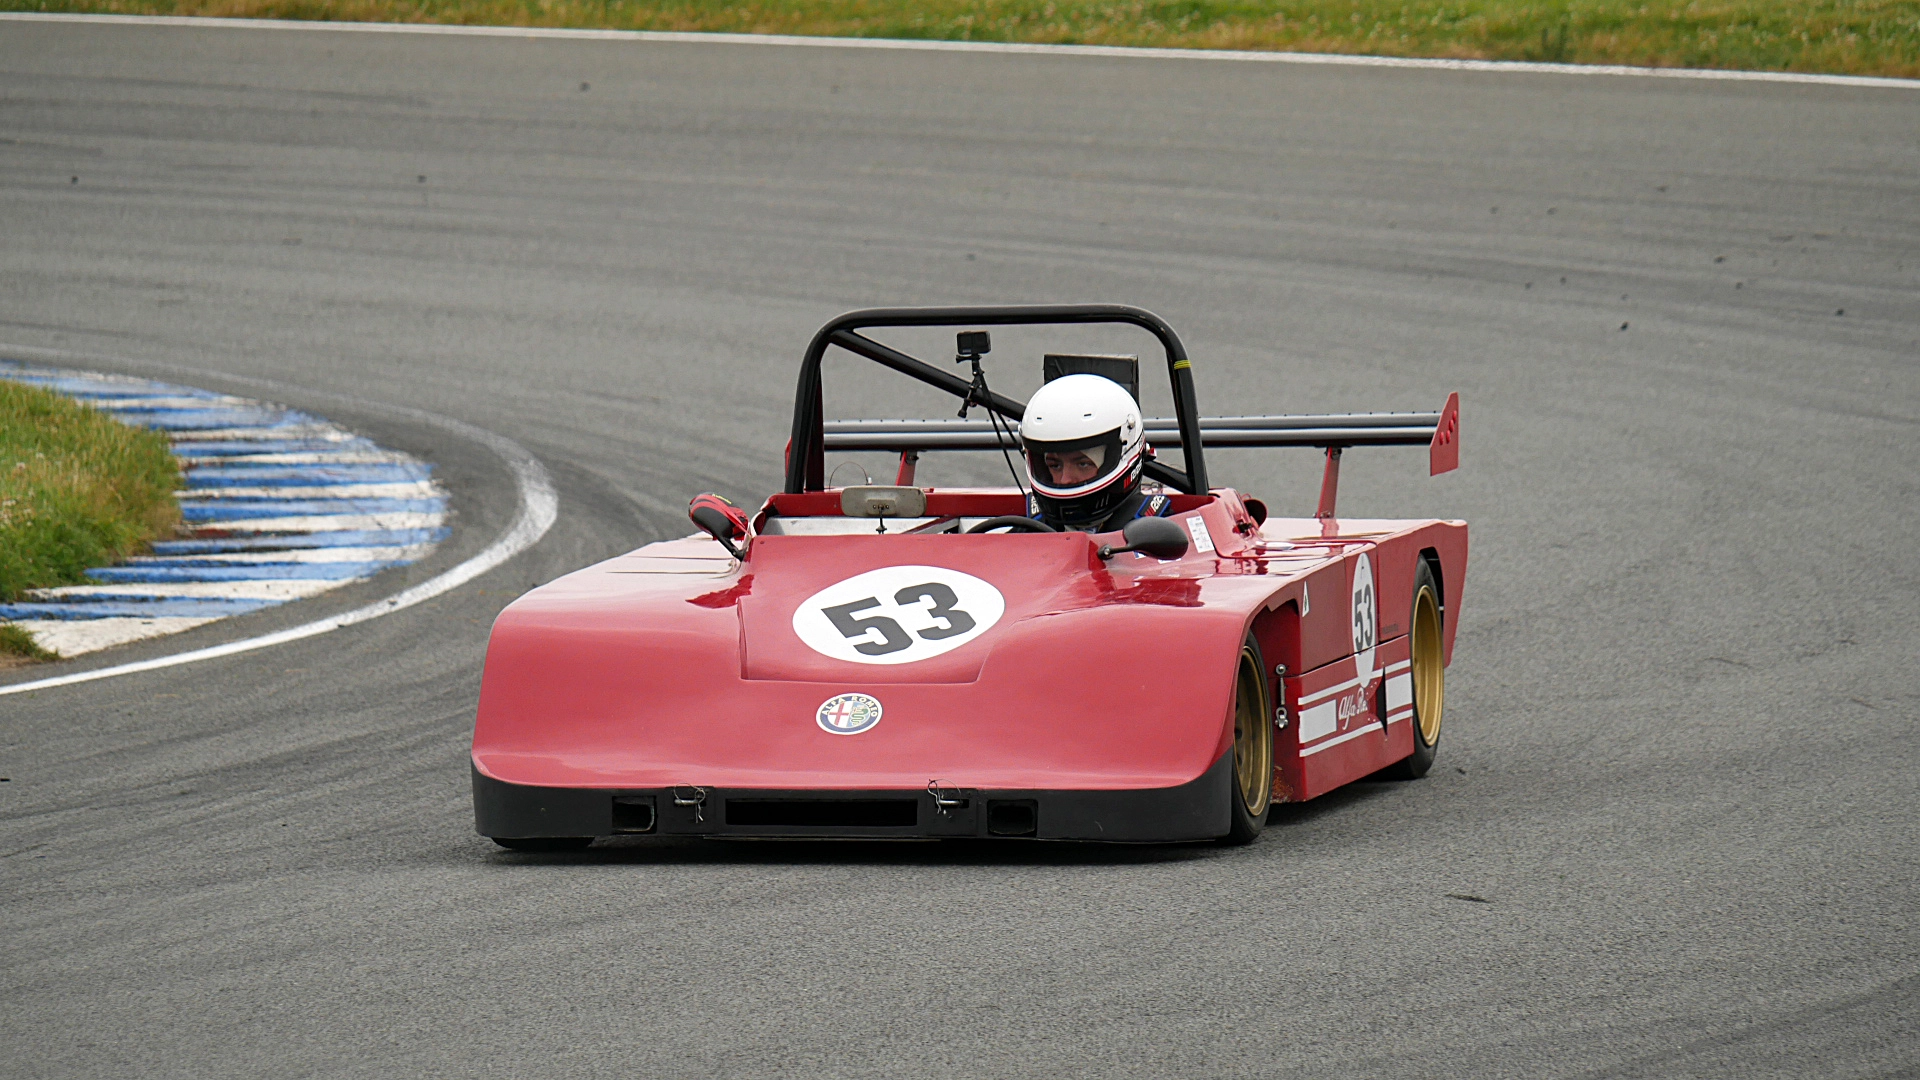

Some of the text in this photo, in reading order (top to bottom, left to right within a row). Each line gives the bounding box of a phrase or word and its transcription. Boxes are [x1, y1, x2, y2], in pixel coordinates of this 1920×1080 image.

[820, 582, 977, 656] 53
[1354, 583, 1374, 655] 53
[821, 695, 879, 718] ALFA ROMEO
